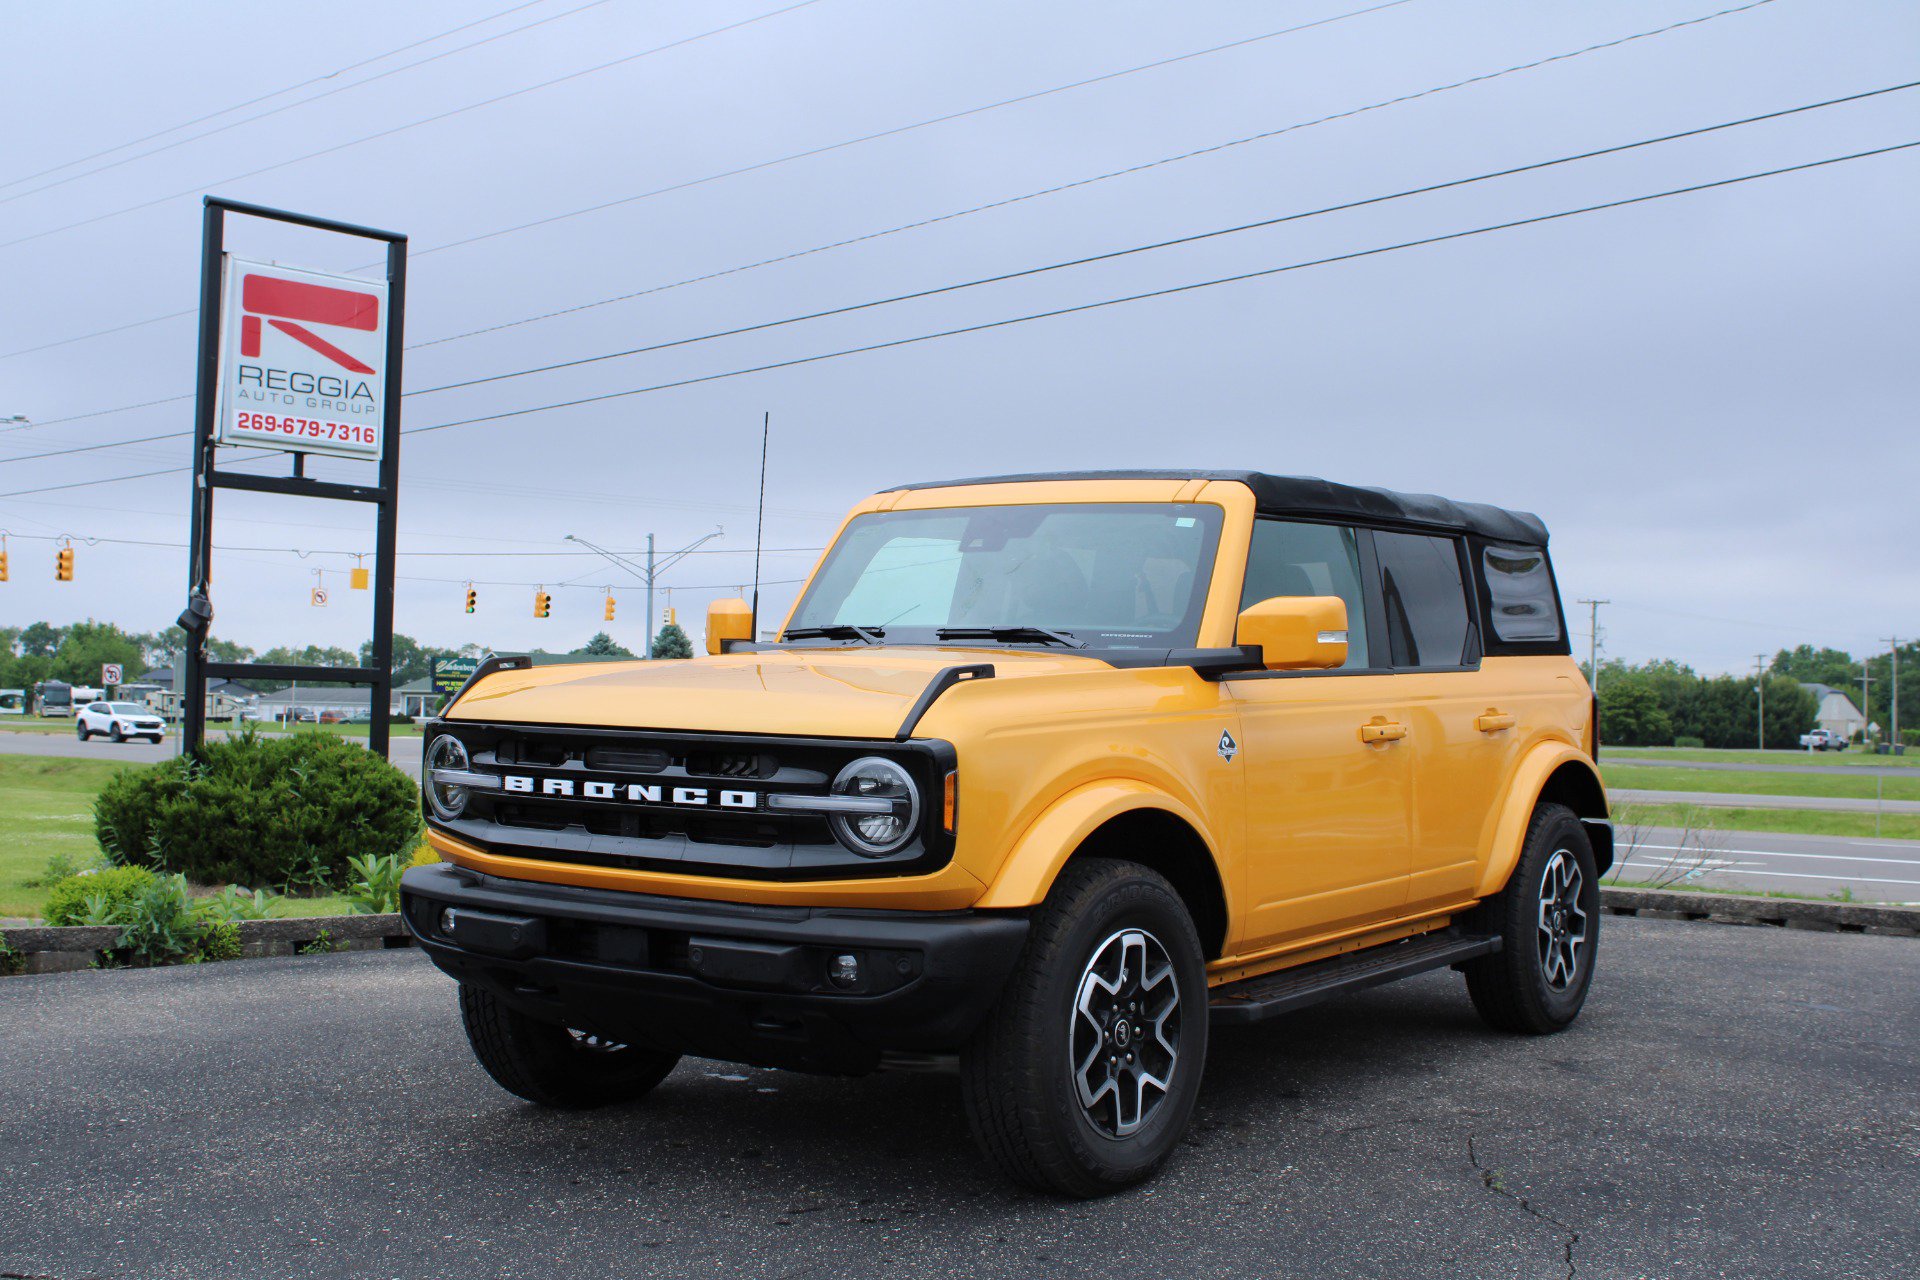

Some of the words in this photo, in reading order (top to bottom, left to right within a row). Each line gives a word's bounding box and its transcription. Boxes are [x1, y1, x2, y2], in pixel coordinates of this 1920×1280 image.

[239, 364, 374, 402] REGGIA
[238, 389, 294, 405] AUTO
[306, 397, 375, 414] GROUP
[238, 412, 375, 444] 269-679-7316
[504, 775, 758, 808] BRONCO
